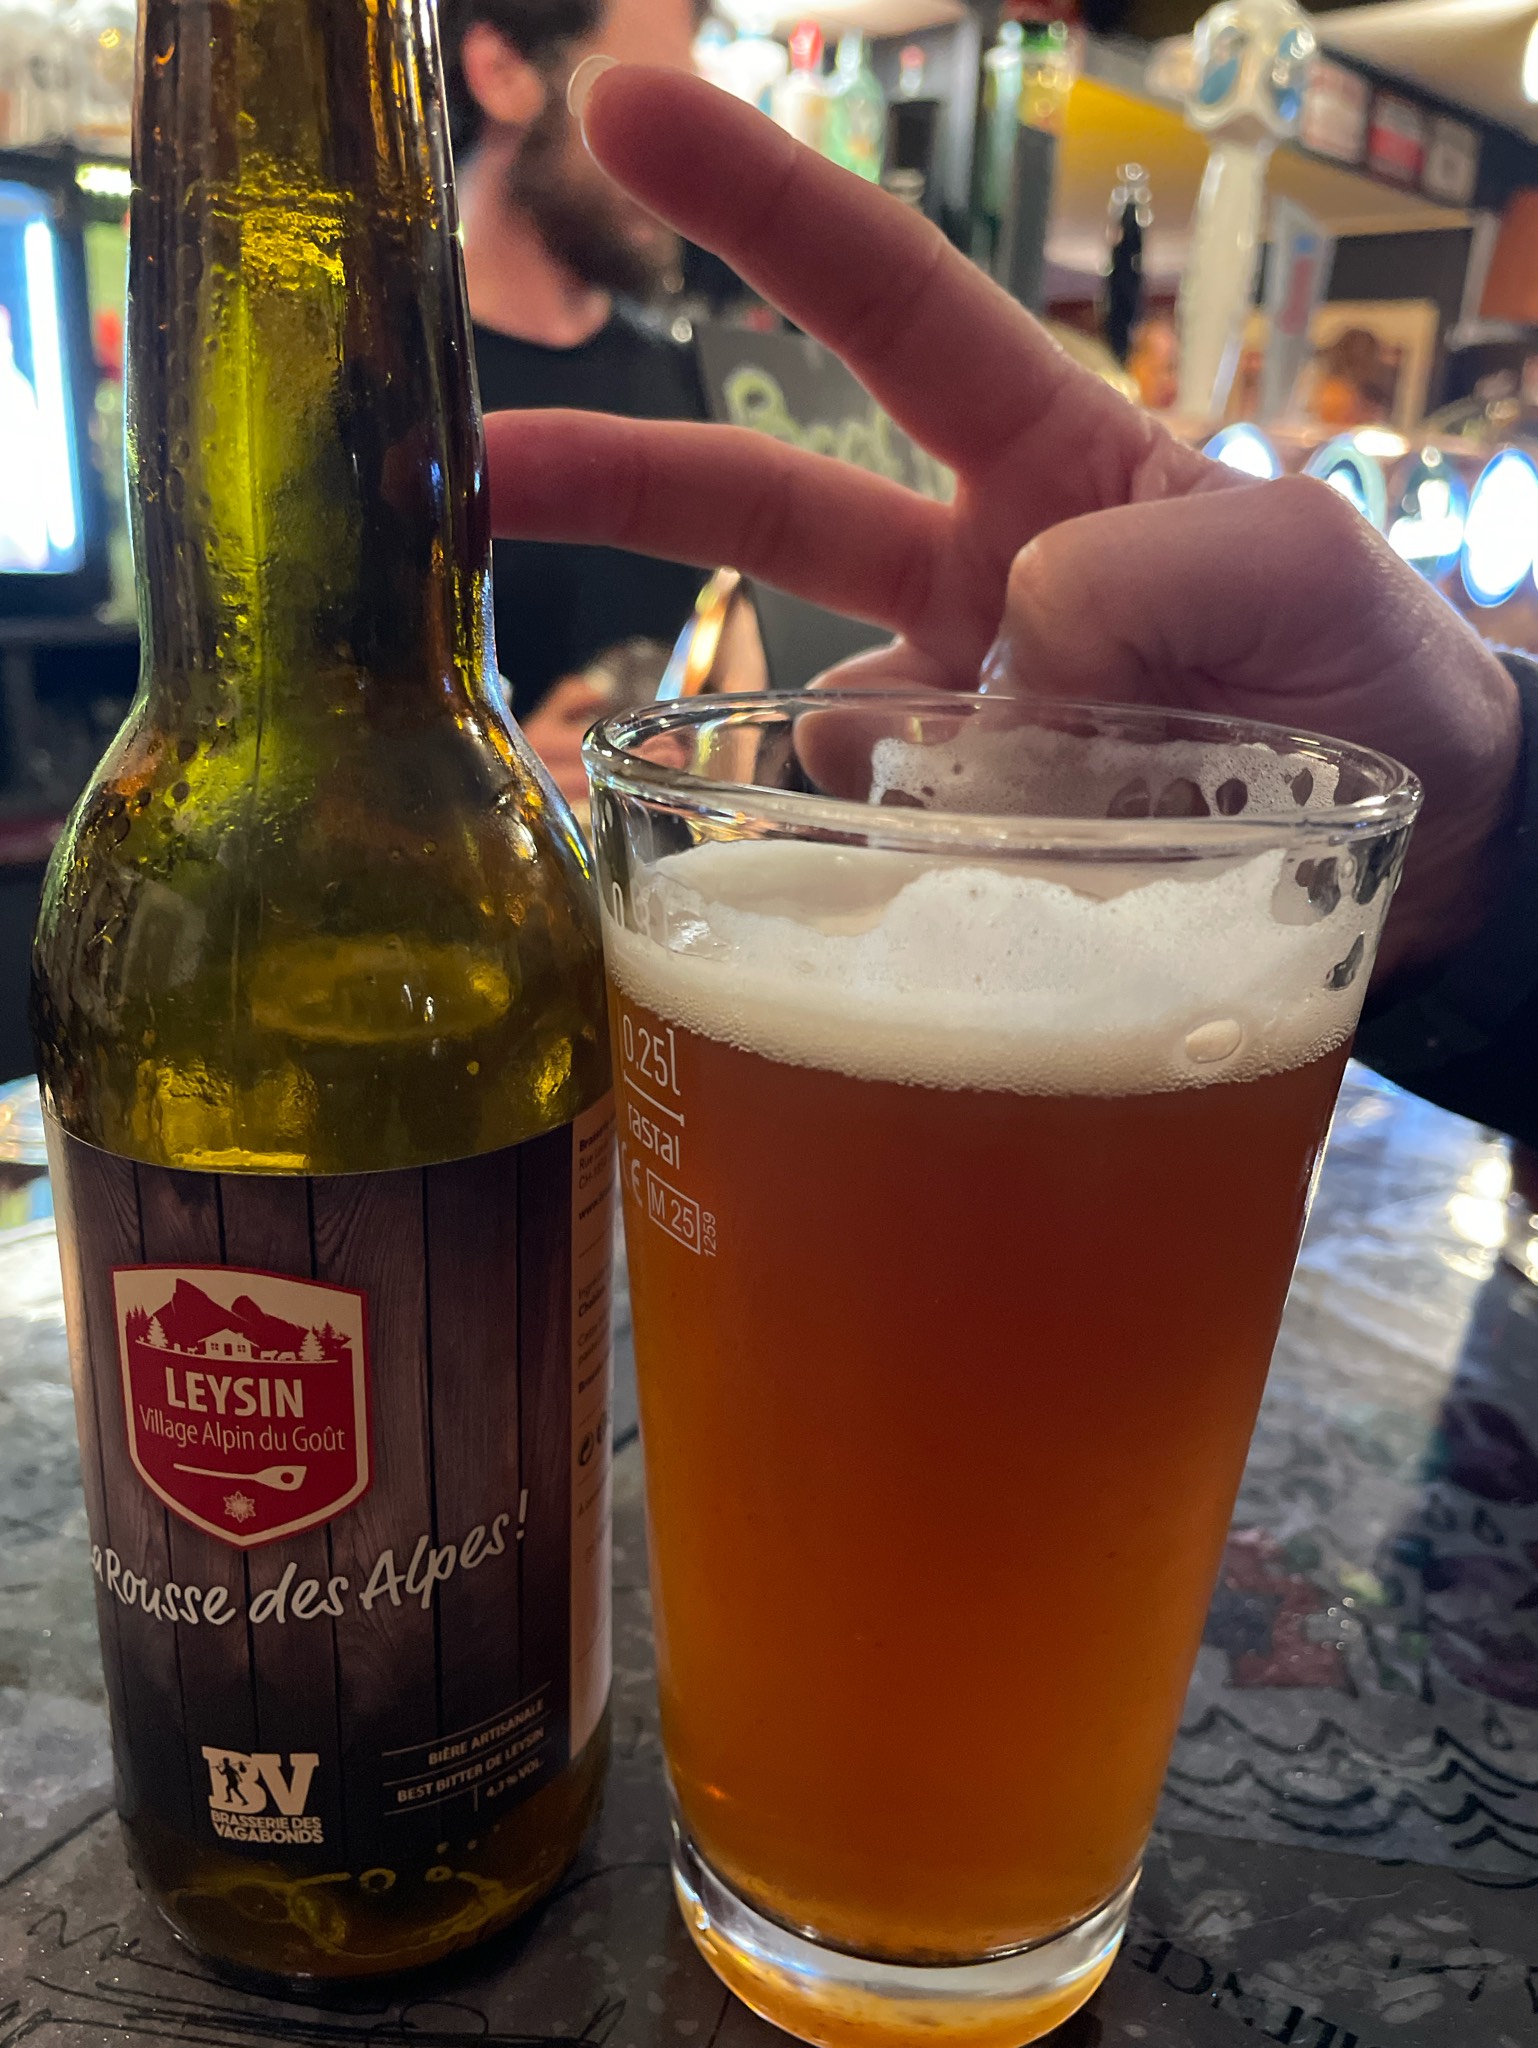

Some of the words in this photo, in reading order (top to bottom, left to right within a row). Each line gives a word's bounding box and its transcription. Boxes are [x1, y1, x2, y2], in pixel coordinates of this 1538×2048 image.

[628, 1101, 680, 1170] rastal
[650, 1181, 666, 1220] M
[670, 1199, 695, 1239] 25
[702, 1210, 717, 1257] 1259
[164, 1366, 305, 1419] LEYSIN
[138, 1403, 199, 1448] Village
[201, 1420, 256, 1455] Alpin
[258, 1424, 288, 1452] du
[291, 1425, 346, 1452] Goût
[104, 1547, 236, 1626] Rousse
[248, 1561, 350, 1625] des
[358, 1487, 529, 1611] Alpes!
[396, 1782, 434, 1803] BEST
[436, 1763, 484, 1793] BITTER
[486, 1754, 503, 1772] DE
[504, 1726, 545, 1760] LEYSIN
[428, 1741, 469, 1766] BIÈRE
[210, 1809, 289, 1830] BRASSERIE
[291, 1816, 322, 1831] DES
[212, 1822, 325, 1845] VAGABONDS
